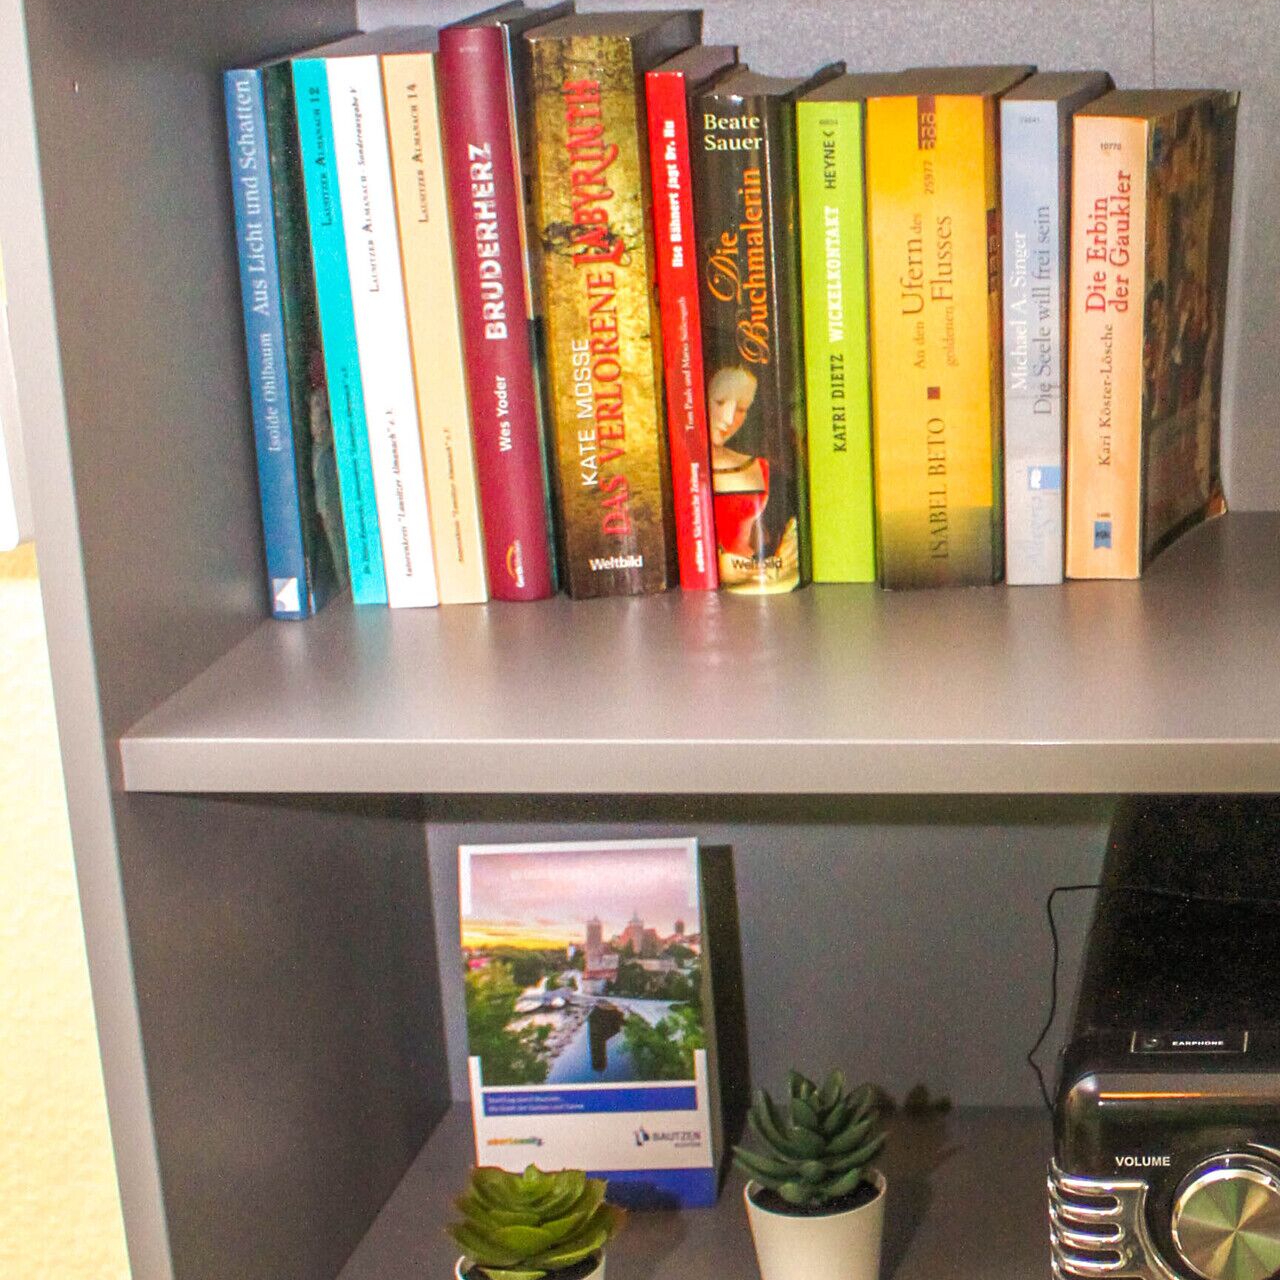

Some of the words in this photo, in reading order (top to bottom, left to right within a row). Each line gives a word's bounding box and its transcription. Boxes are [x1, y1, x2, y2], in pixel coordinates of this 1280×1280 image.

[236, 80, 258, 170] Schatten
[703, 113, 761, 131] Beate
[703, 133, 763, 152] Sauer
[563, 78, 625, 267] LABYRINTH
[824, 141, 837, 190] HEYNE
[241, 175, 261, 215] und
[467, 142, 507, 340] BRUDERHERZ
[911, 212, 924, 233] des
[1034, 206, 1052, 244] sein
[1085, 196, 1108, 269] Erbin
[1109, 170, 1132, 272] Gaukler
[246, 223, 266, 273] Licht
[706, 230, 741, 304] Die
[736, 167, 769, 364] Buchmalerin
[930, 215, 954, 304] Flusses
[1010, 230, 1031, 288] Singer
[1030, 249, 1051, 280] frei
[252, 278, 272, 317] Aus
[823, 204, 845, 343] WICKELKONTAKT
[901, 235, 927, 317] Ufern
[1084, 275, 1107, 314] Die
[1109, 278, 1130, 314] der
[1030, 286, 1051, 320] will
[912, 320, 926, 345] den
[945, 306, 959, 367] goldenen
[1010, 321, 1029, 391] Michael
[1031, 326, 1052, 377] Seele
[260, 333, 278, 402] Ohlbaum
[575, 339, 593, 419] MOSSE
[586, 270, 623, 465] VERLORENE
[830, 353, 845, 401] DIETZ
[913, 349, 927, 370] An
[1096, 323, 1115, 428] Köster-Lösche
[496, 375, 510, 413] Yoder
[1033, 384, 1053, 416] Die
[265, 407, 282, 453] Isolde
[499, 415, 513, 453] Wes
[833, 405, 847, 453] KATRI
[927, 415, 949, 478] BETO
[1098, 435, 1113, 466] Kari
[580, 427, 598, 486] KATE
[602, 471, 633, 536] DAS
[930, 485, 951, 562] ISABEL
[589, 555, 643, 571] Weltbild
[731, 557, 783, 572] Weltbild
[1115, 1156, 1171, 1167] VOLUME
